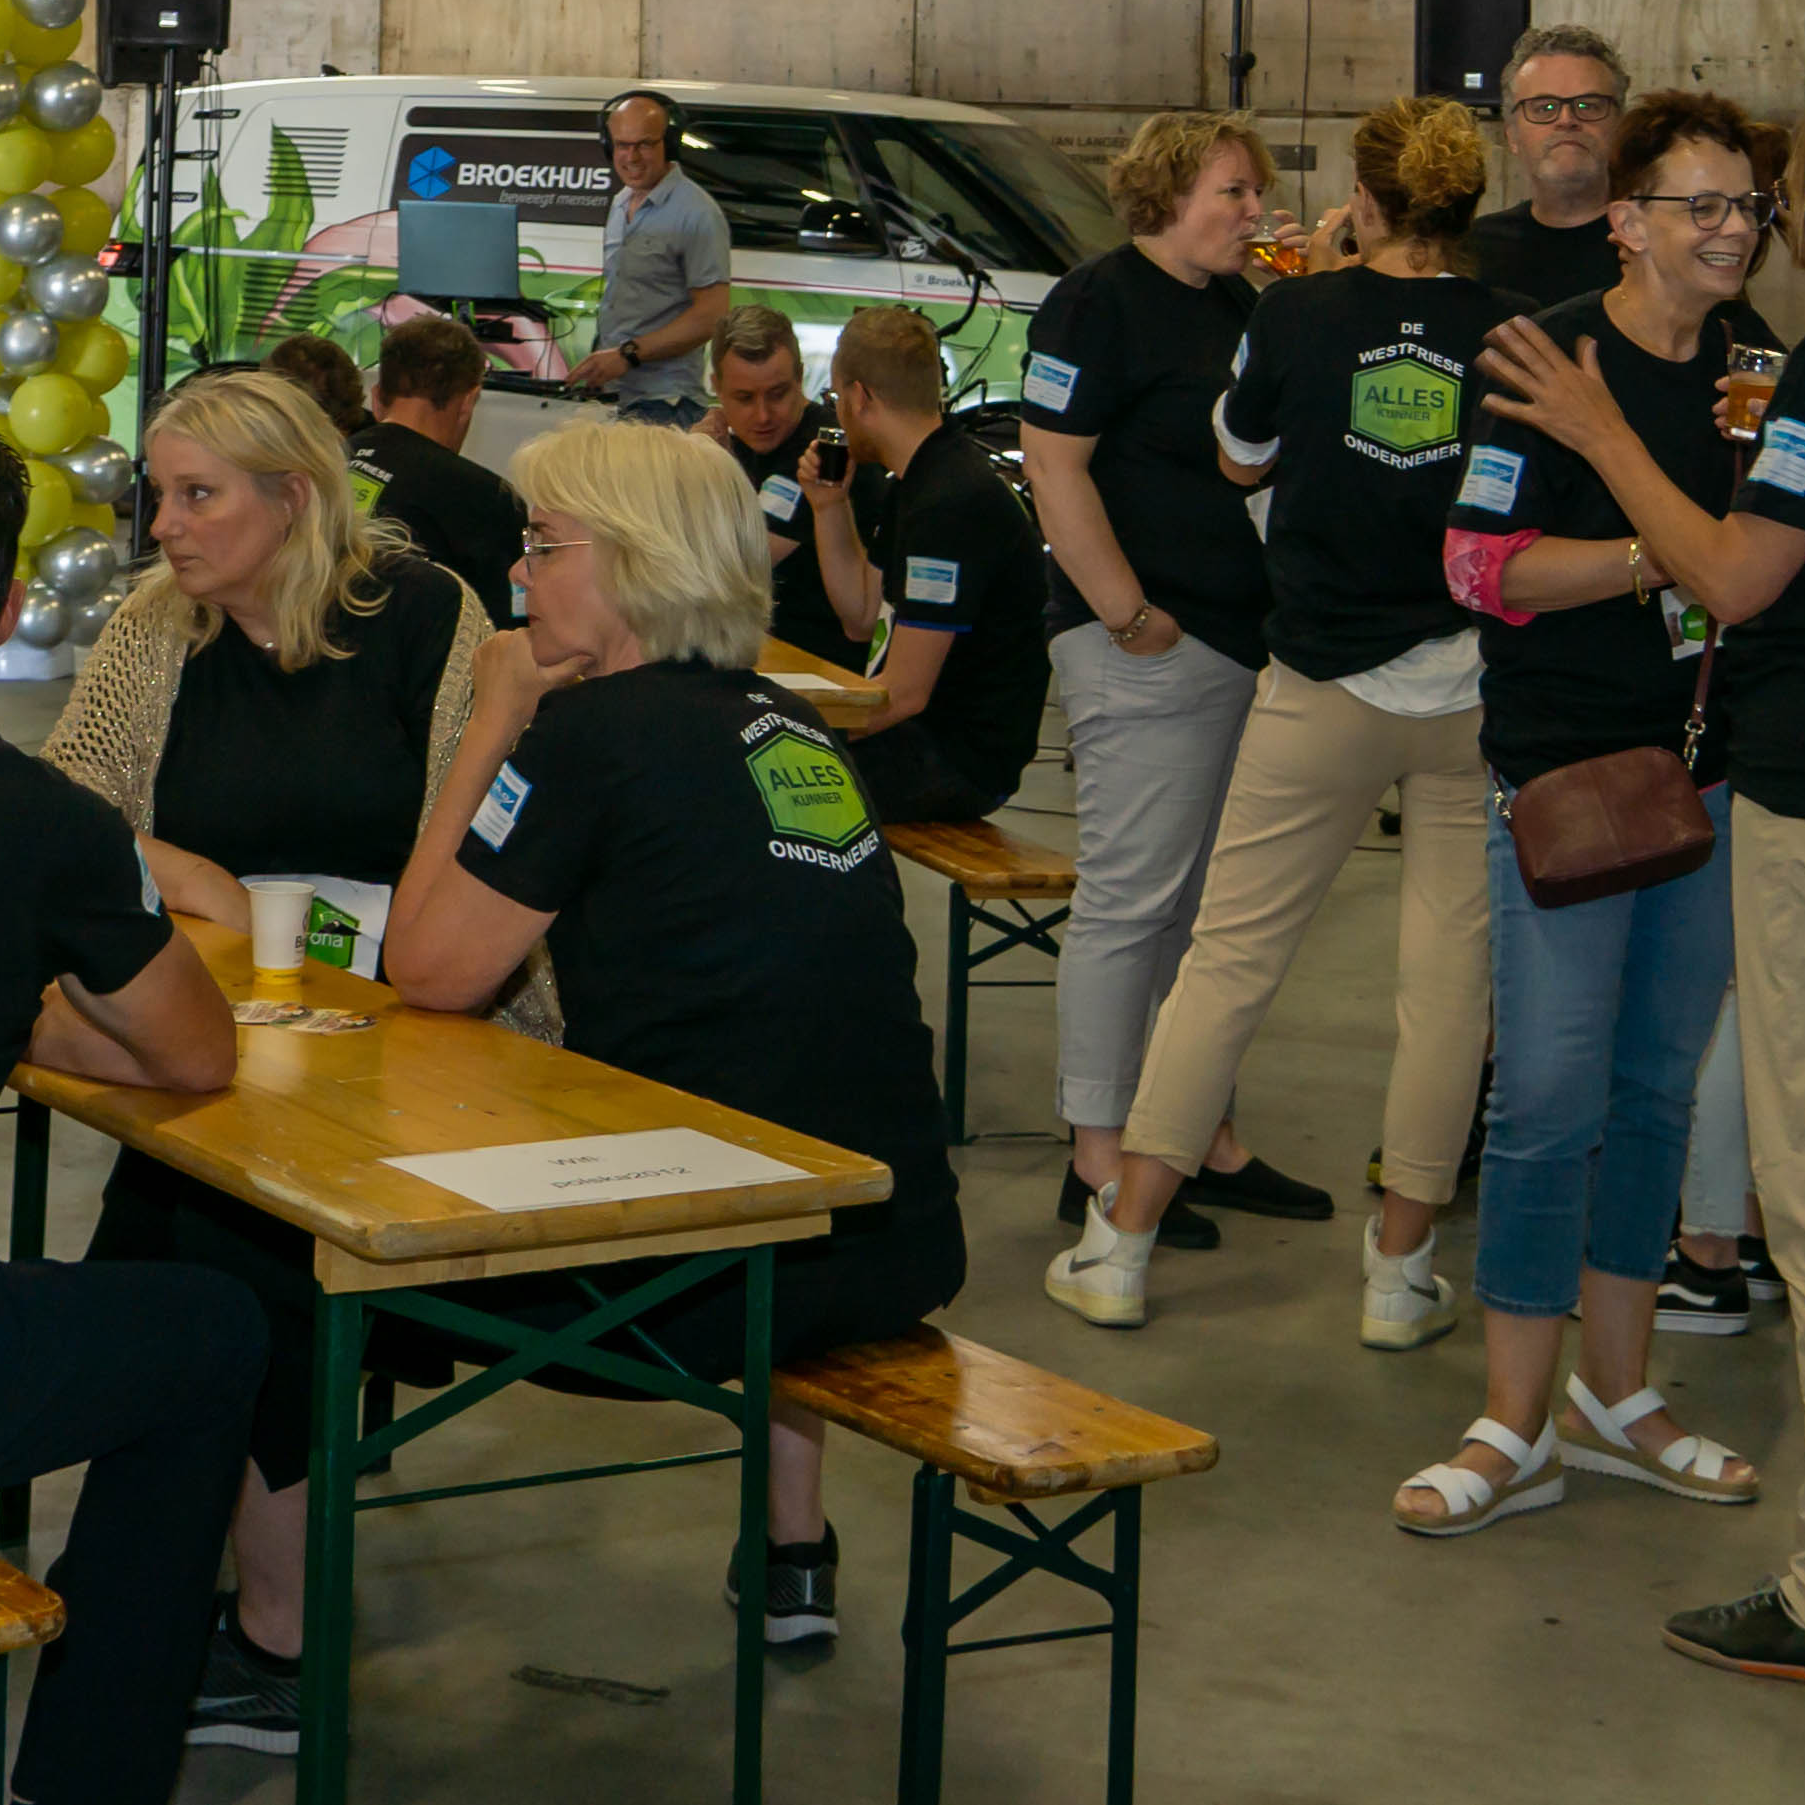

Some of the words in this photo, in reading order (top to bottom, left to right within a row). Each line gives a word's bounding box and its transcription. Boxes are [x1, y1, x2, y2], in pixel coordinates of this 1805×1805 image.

[456, 163, 612, 190] BROEKHUIS
[556, 194, 609, 207] mensen
[1399, 321, 1426, 335] DE
[1358, 342, 1466, 378] WESTFRIESE
[1364, 384, 1446, 410] ALLES
[1343, 434, 1463, 470] ONDERNEMER
[768, 764, 846, 792] ALLES
[793, 791, 844, 808] KUNNER
